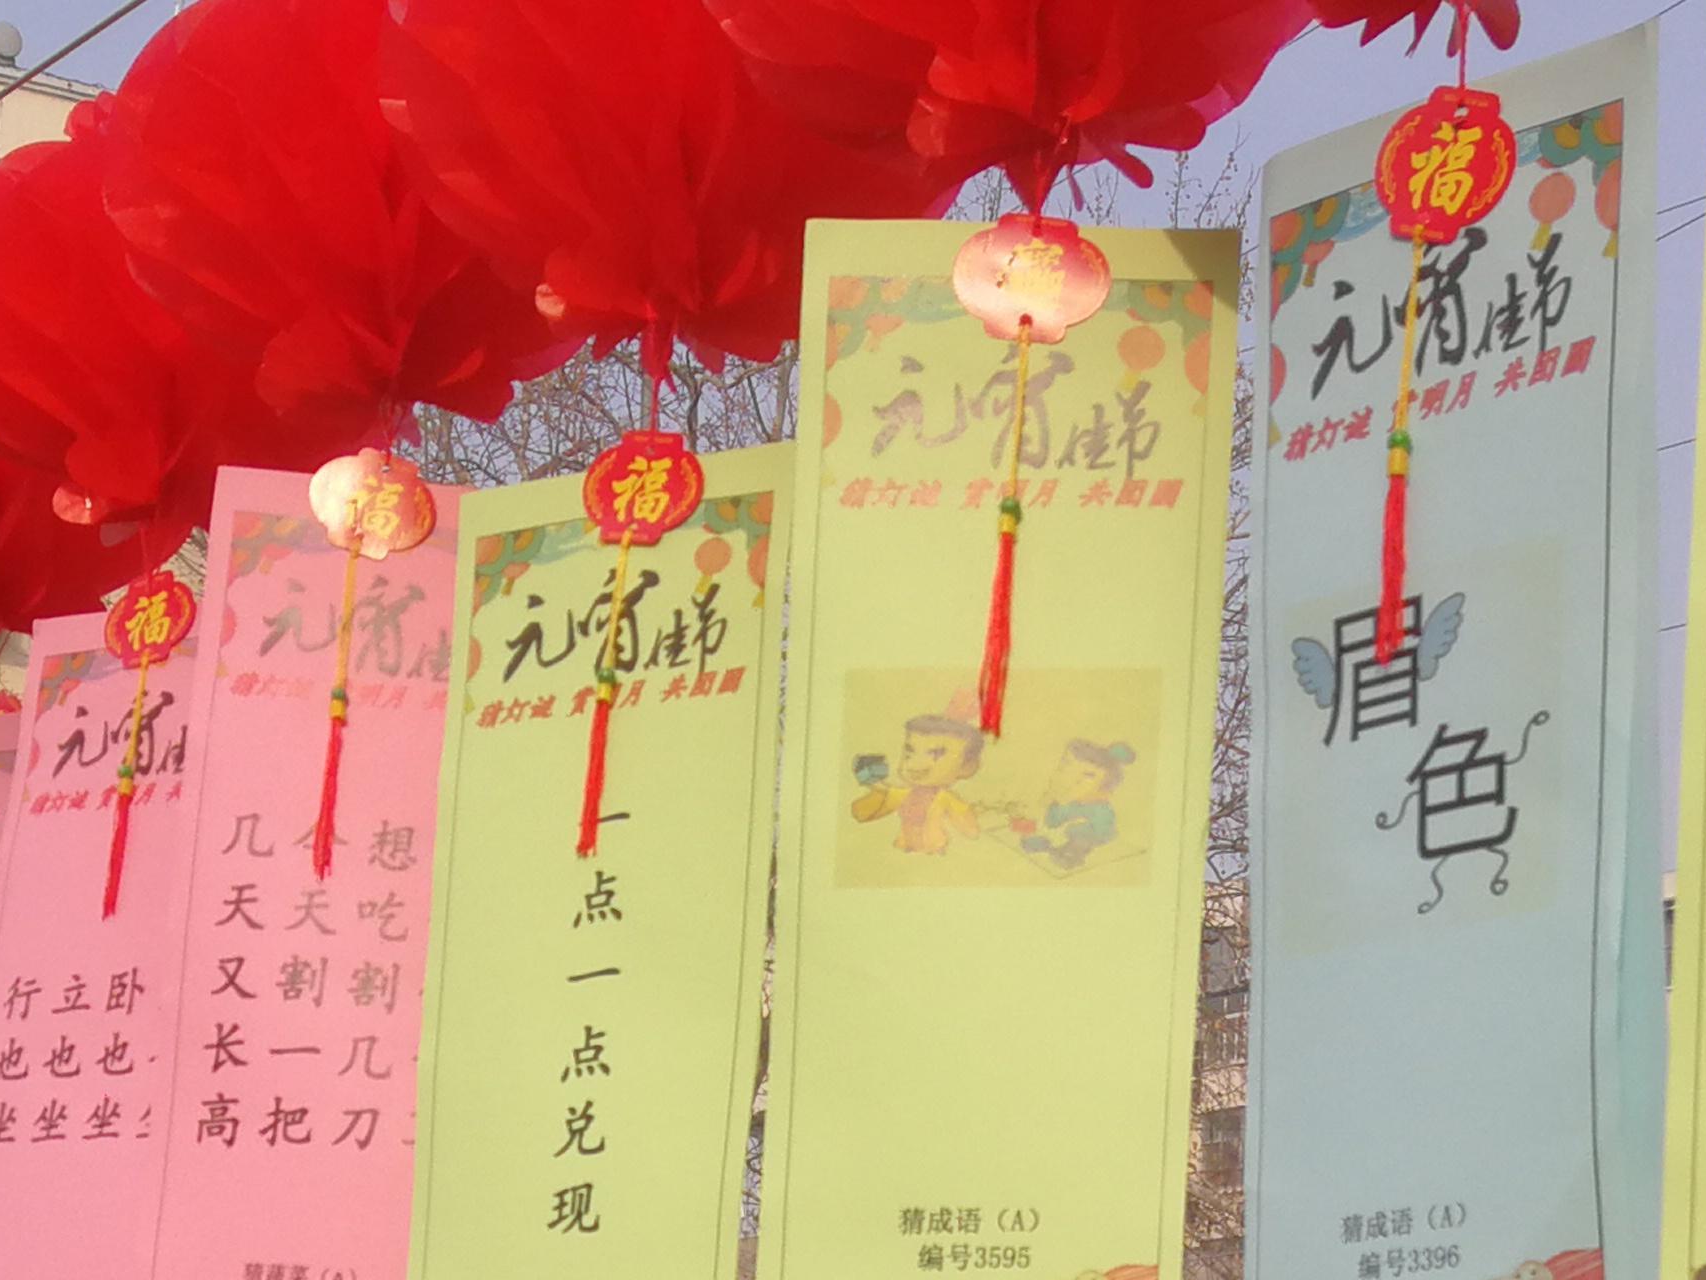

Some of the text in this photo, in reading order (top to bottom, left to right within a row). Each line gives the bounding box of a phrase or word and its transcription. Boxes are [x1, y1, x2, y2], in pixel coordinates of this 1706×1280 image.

[1408, 121, 1482, 215] 福
[612, 458, 672, 523] 福
[125, 590, 171, 651] 福
[197, 812, 274, 1148] 几天又长高
[333, 820, 418, 1150] 想吃割几刀
[547, 813, 631, 1235] 一点一点兑现
[32, 975, 90, 1143] 立也坐
[83, 968, 144, 1140] 卧也坐
[918, 1244, 1032, 1271] 编号3595
[1358, 1244, 1461, 1280] 编号3396
